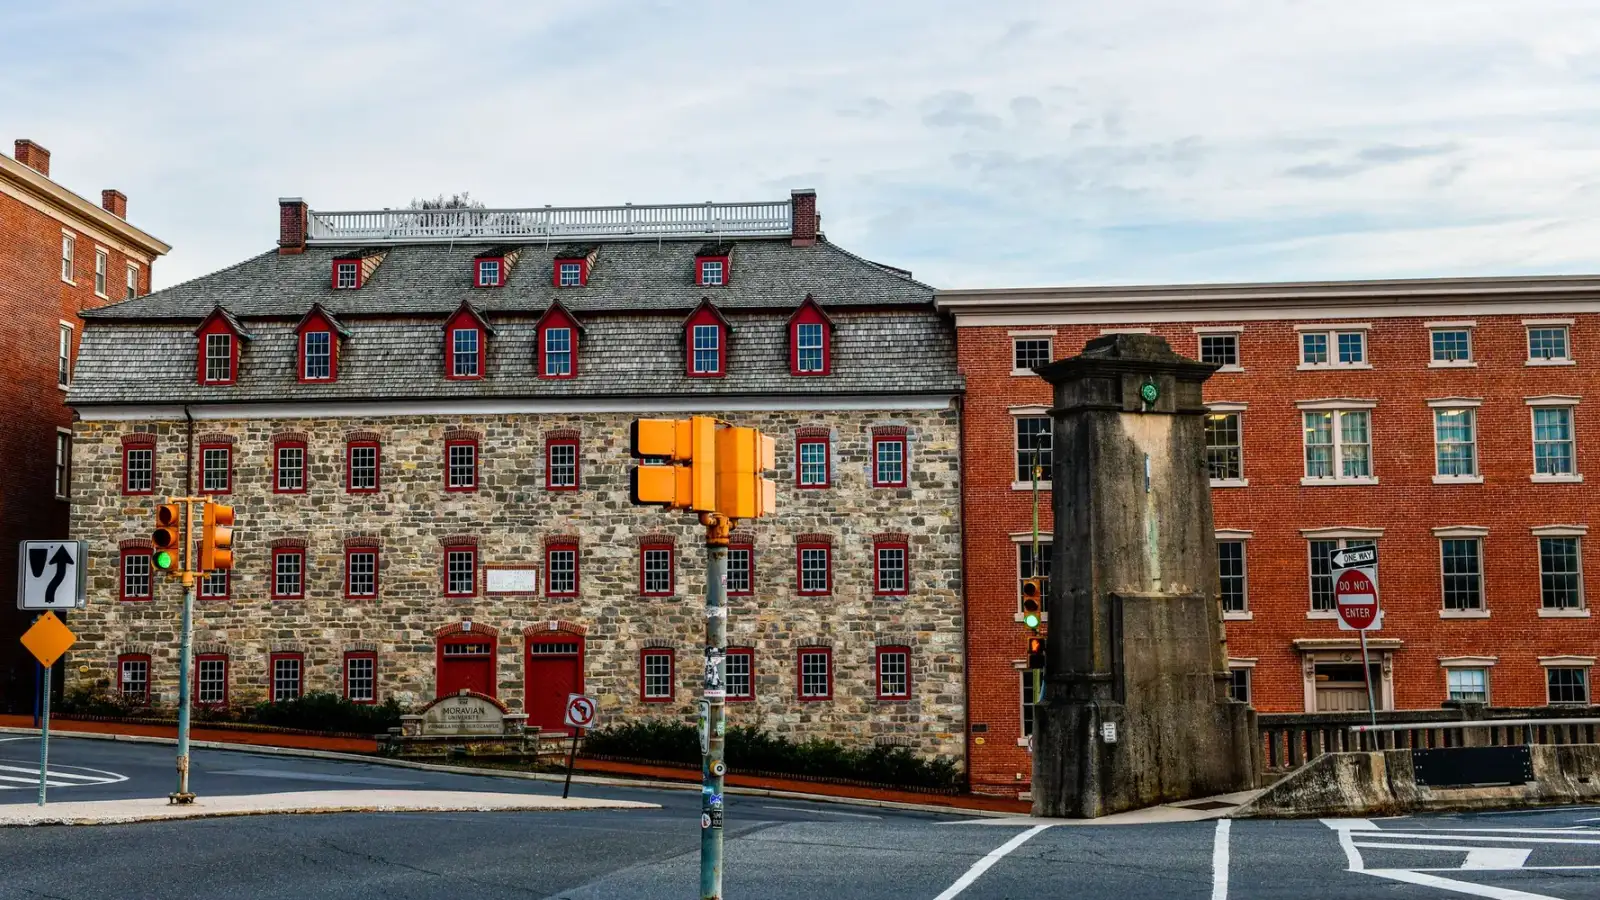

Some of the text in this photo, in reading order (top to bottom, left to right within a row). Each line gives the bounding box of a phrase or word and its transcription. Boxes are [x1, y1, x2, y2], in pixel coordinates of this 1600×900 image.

[1344, 552, 1372, 562] ONE WAY
[1339, 580, 1369, 590] DO NOT
[1345, 608, 1370, 618] ENTER
